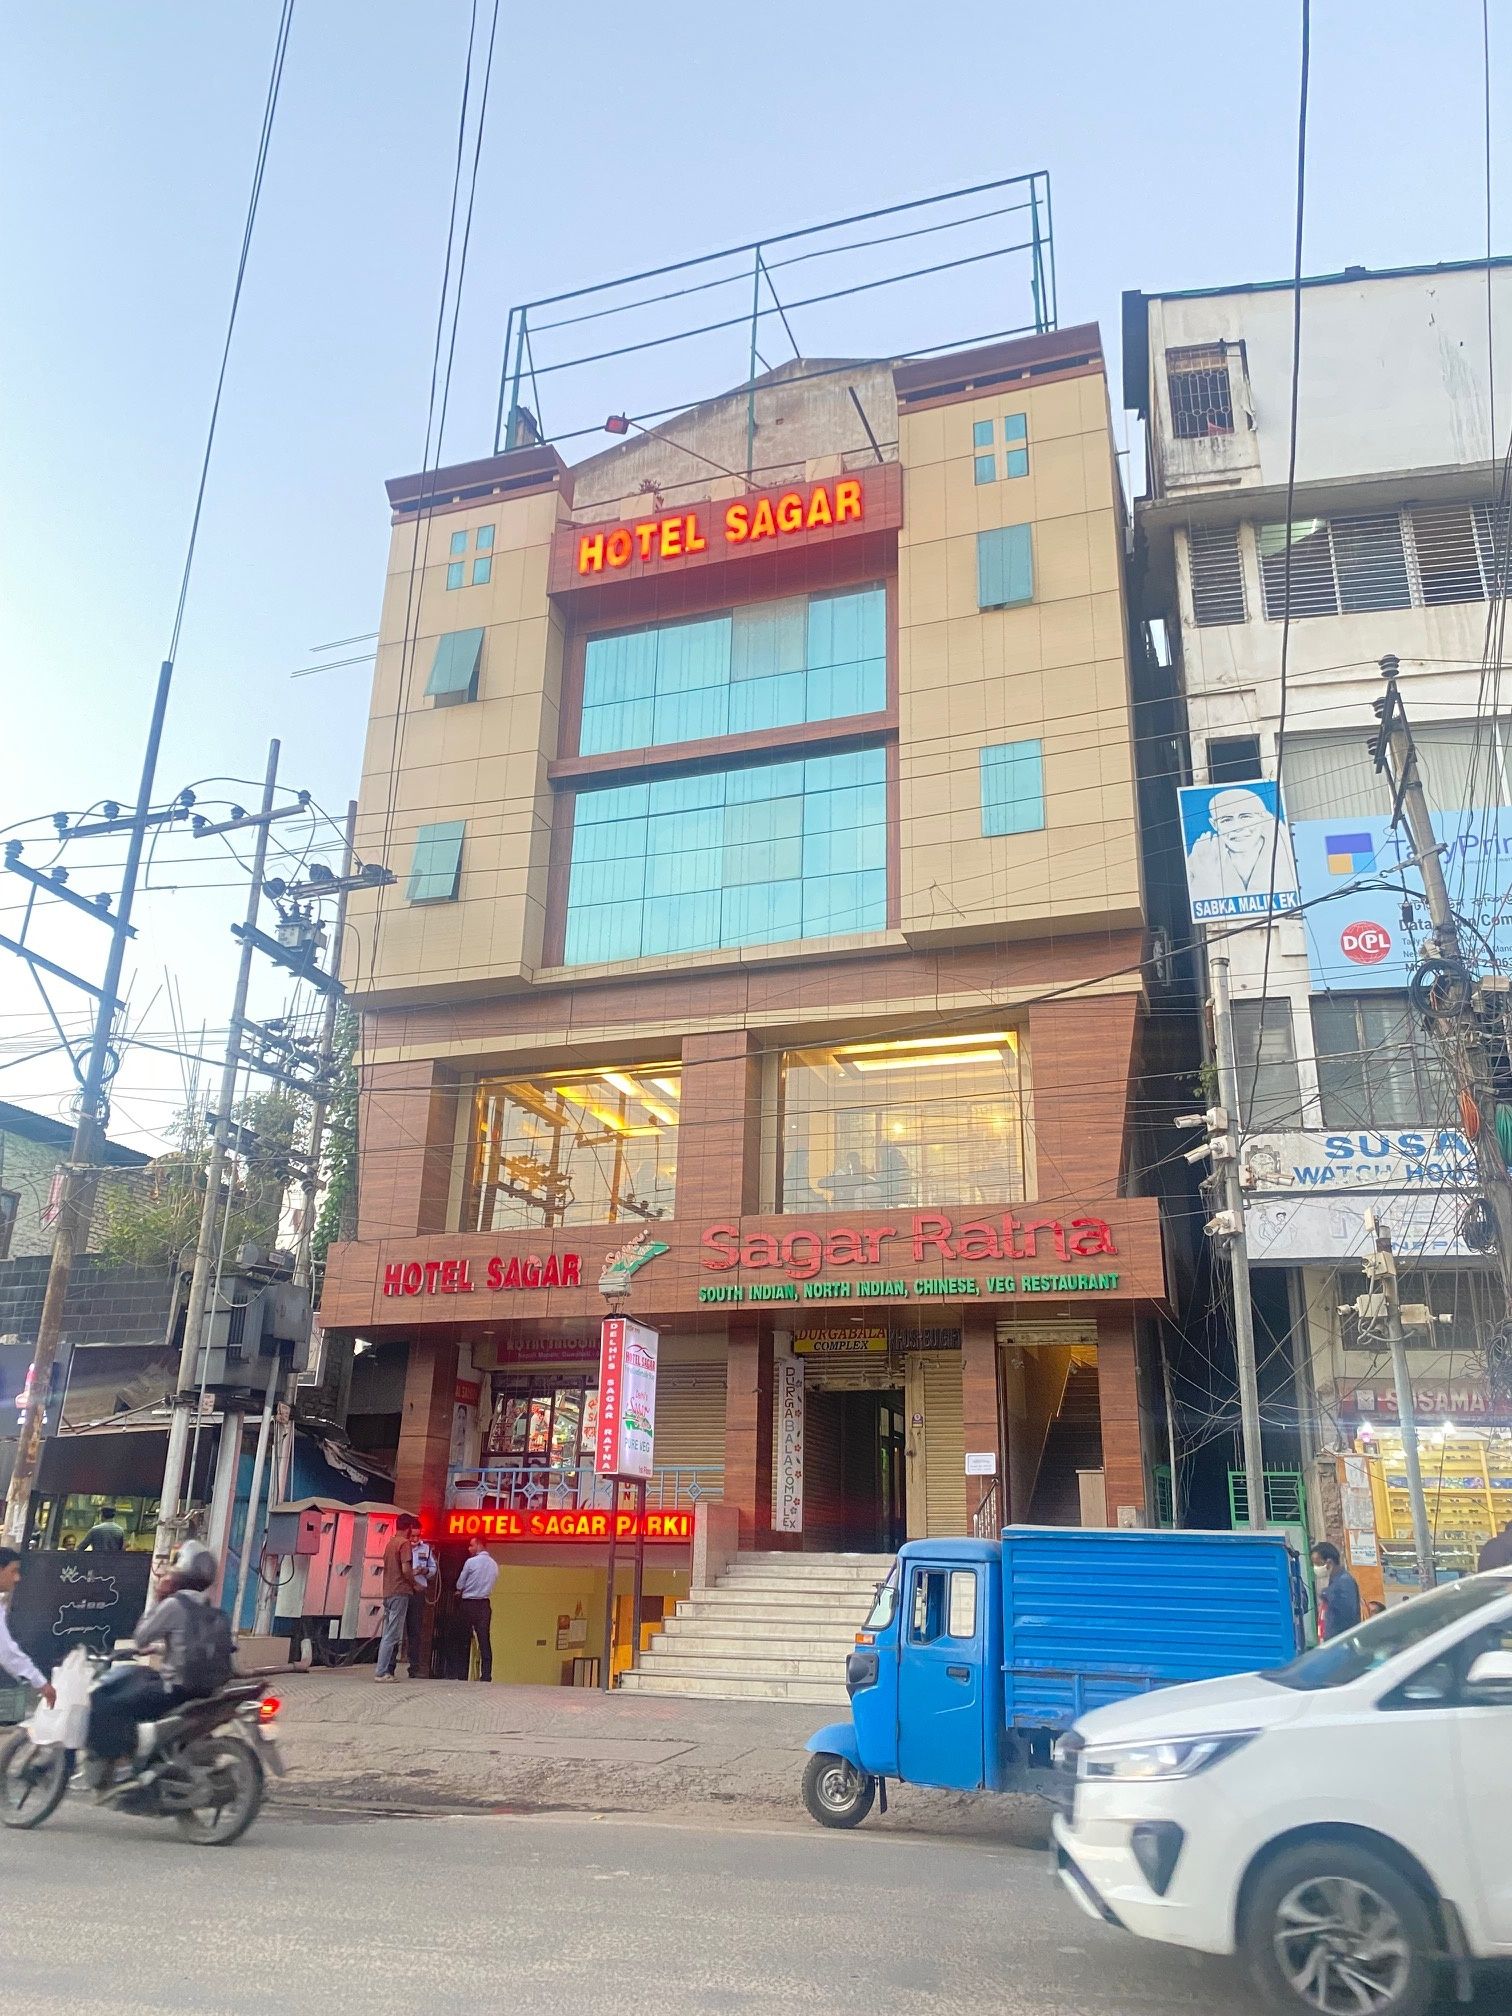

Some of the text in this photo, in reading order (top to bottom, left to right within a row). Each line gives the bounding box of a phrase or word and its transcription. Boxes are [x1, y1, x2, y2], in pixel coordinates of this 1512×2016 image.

[579, 480, 862, 575] HOTEL SAGAR
[1195, 900, 1236, 917] SABKA
[1343, 930, 1390, 953] DCPL
[702, 1211, 1118, 1279] Sagar Ratna
[384, 1253, 582, 1296] HOTEL SAGAR
[699, 1273, 1119, 1302] SOUTH INDIAN, NORTH INDIAN, CHINESE, VEG RESTAURANT
[796, 1328, 886, 1351] DURGABALA COMPLEX
[625, 1352, 655, 1373] HOTEL SAGAR
[602, 1323, 619, 1469] DELHI'S SAGAR RATNA
[1385, 1387, 1486, 1412] SSAMA
[624, 1437, 650, 1453] PURE VEG
[450, 1515, 521, 1534] HOTEL
[530, 1515, 606, 1536] SAGAR
